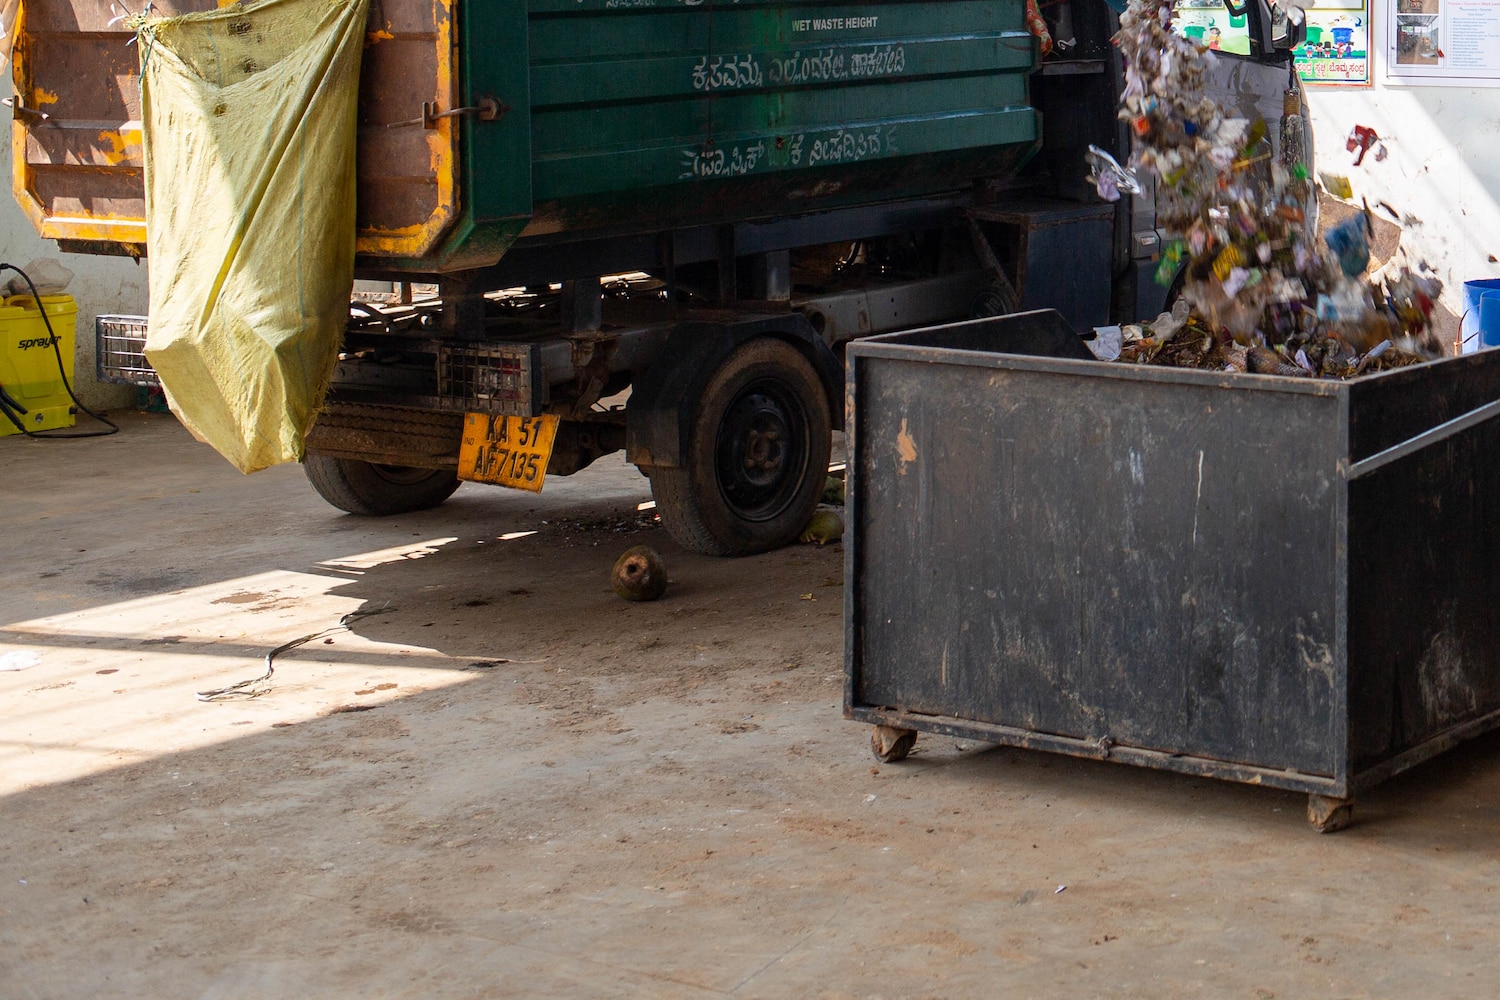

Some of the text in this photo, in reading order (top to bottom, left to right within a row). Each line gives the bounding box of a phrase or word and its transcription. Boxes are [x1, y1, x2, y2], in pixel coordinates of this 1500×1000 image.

[791, 16, 878, 33] WET WASTE HEIGHT
[487, 415, 543, 448] KA 51
[474, 445, 542, 482] AF7135
